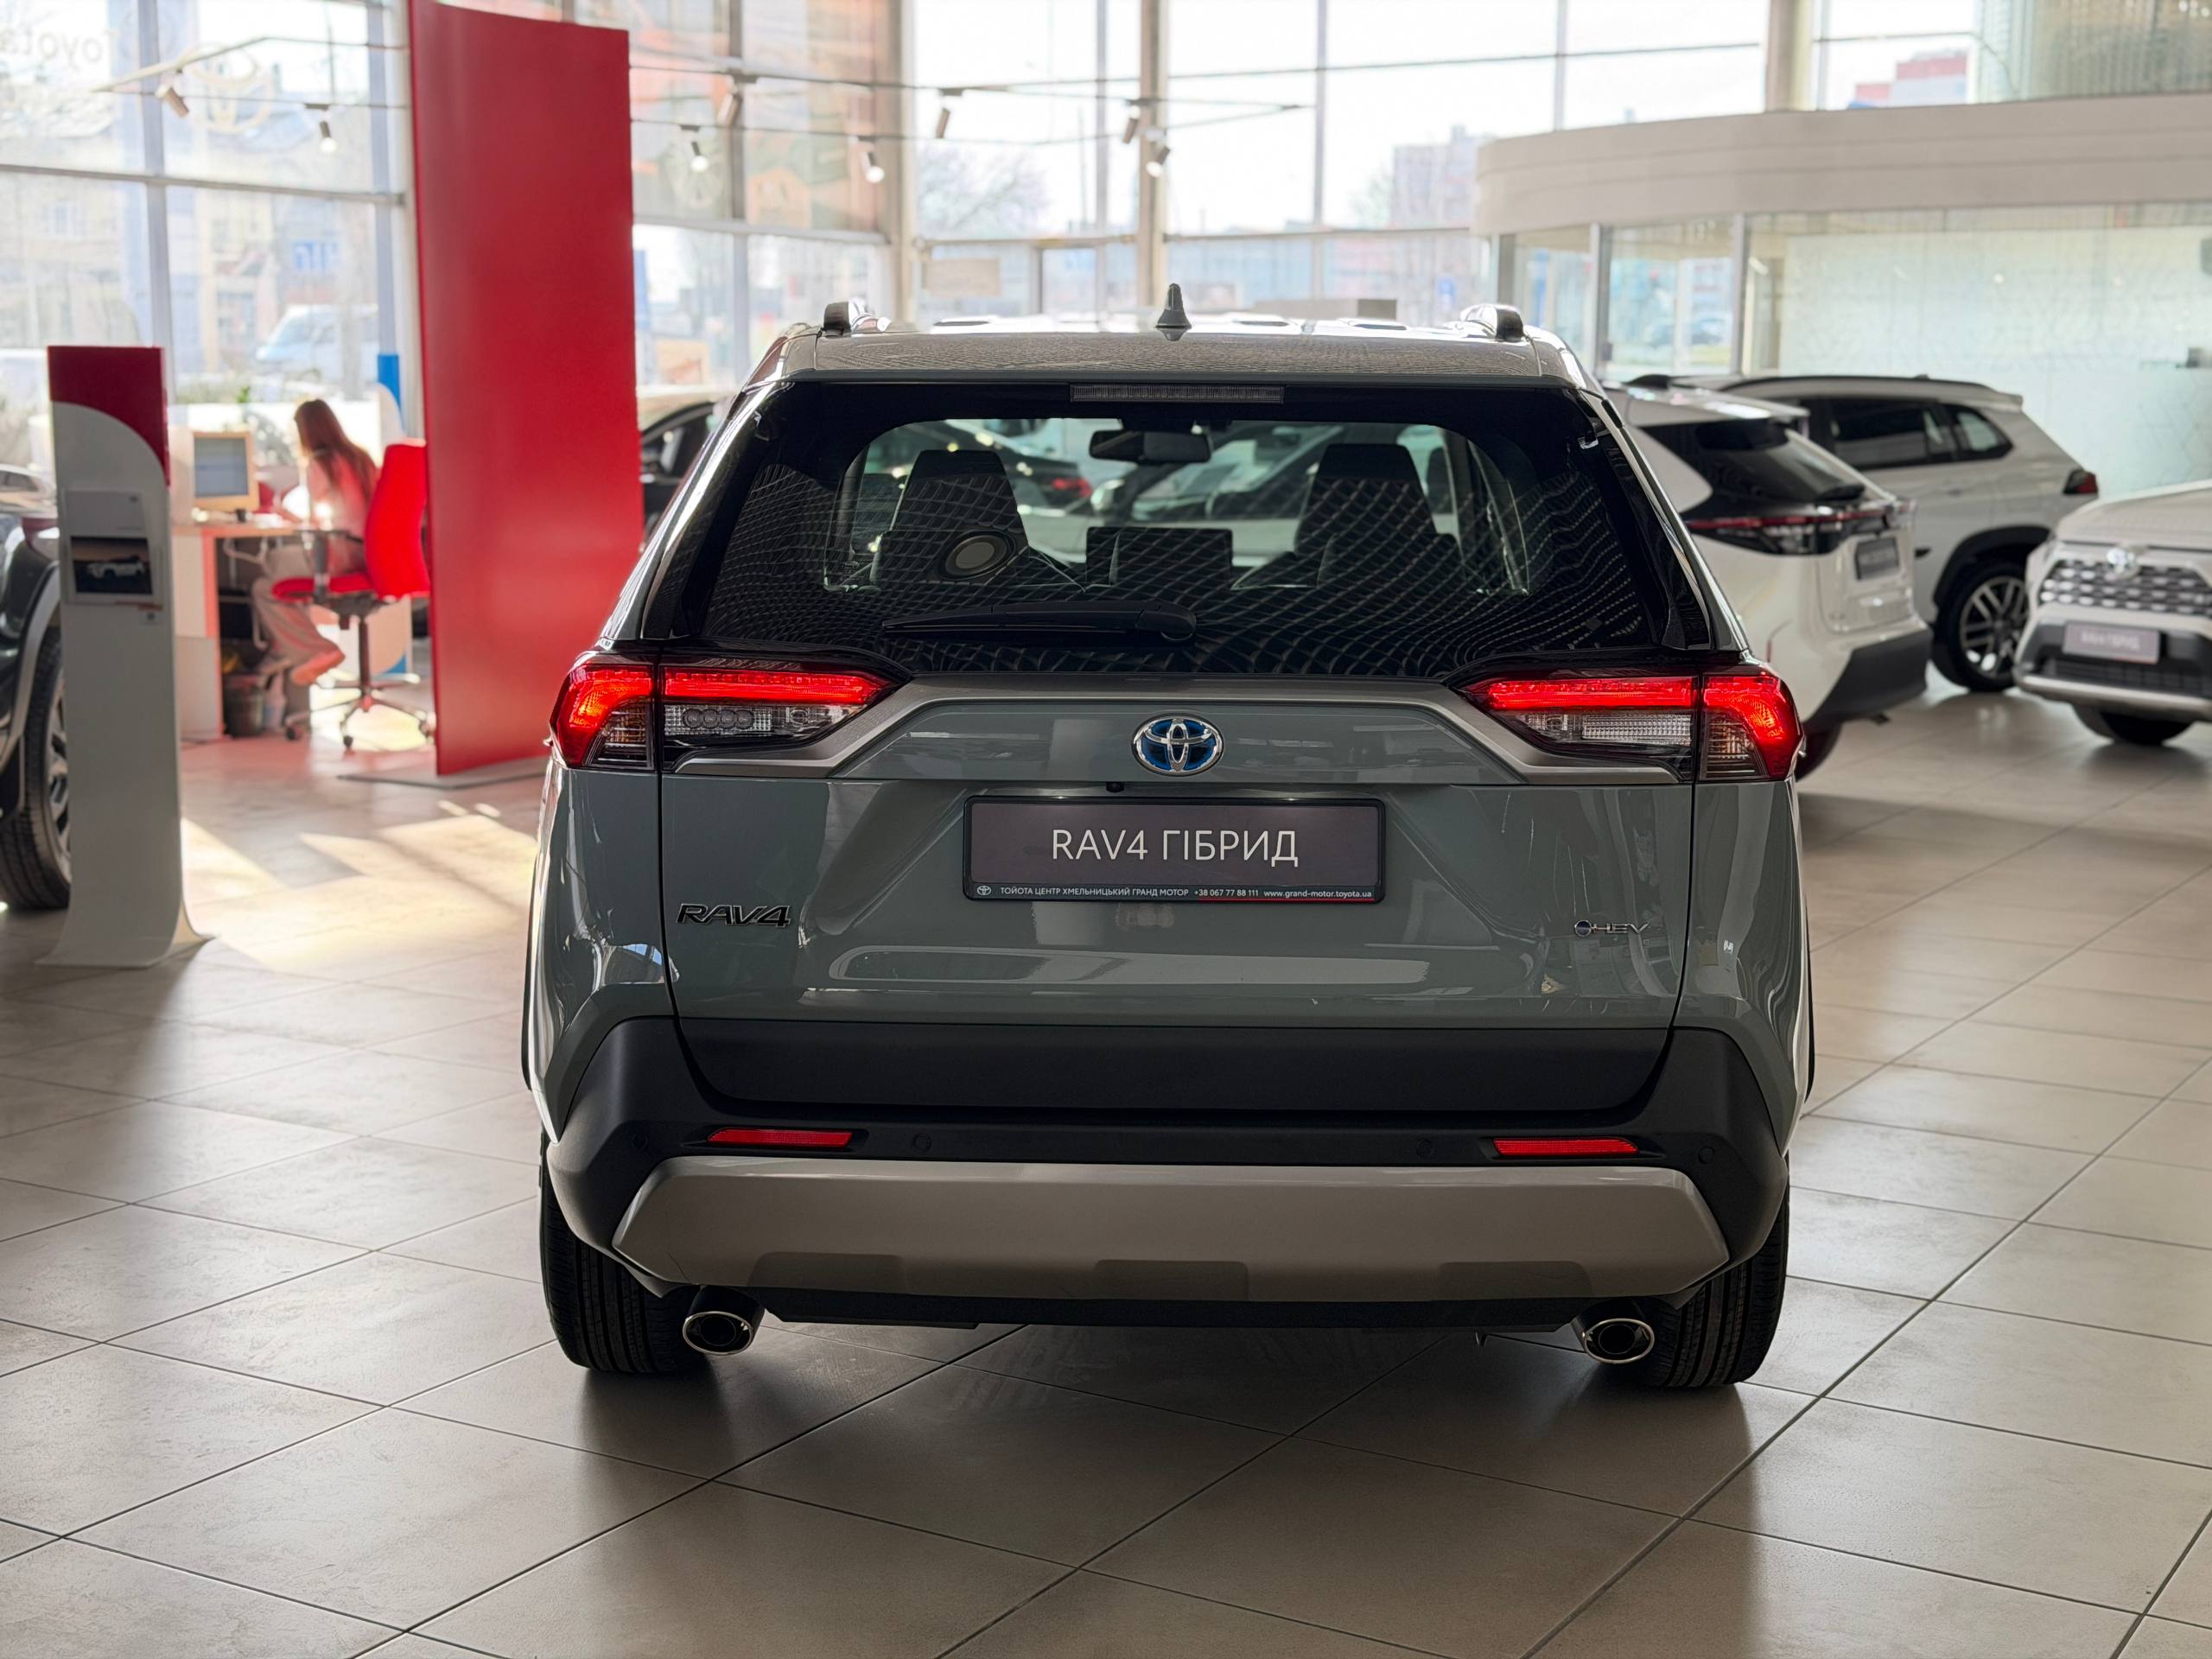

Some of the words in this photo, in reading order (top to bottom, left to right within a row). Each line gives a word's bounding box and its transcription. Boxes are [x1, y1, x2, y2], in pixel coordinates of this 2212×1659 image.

[1052, 830, 1147, 860] RAV4
[1163, 830, 1299, 868] ГІБРИД
[1001, 887, 1033, 895] ТОЙОТА
[1035, 887, 1061, 896] ЦЕНТР
[1062, 887, 1130, 896] ХМЕЛЬНИЦЬКИЙ
[1132, 888, 1159, 897] ГРАНД
[1160, 888, 1189, 897] МОТОР
[1263, 890, 1372, 899] www.grand-motor.toyota.ua
[677, 903, 791, 928] RAV4
